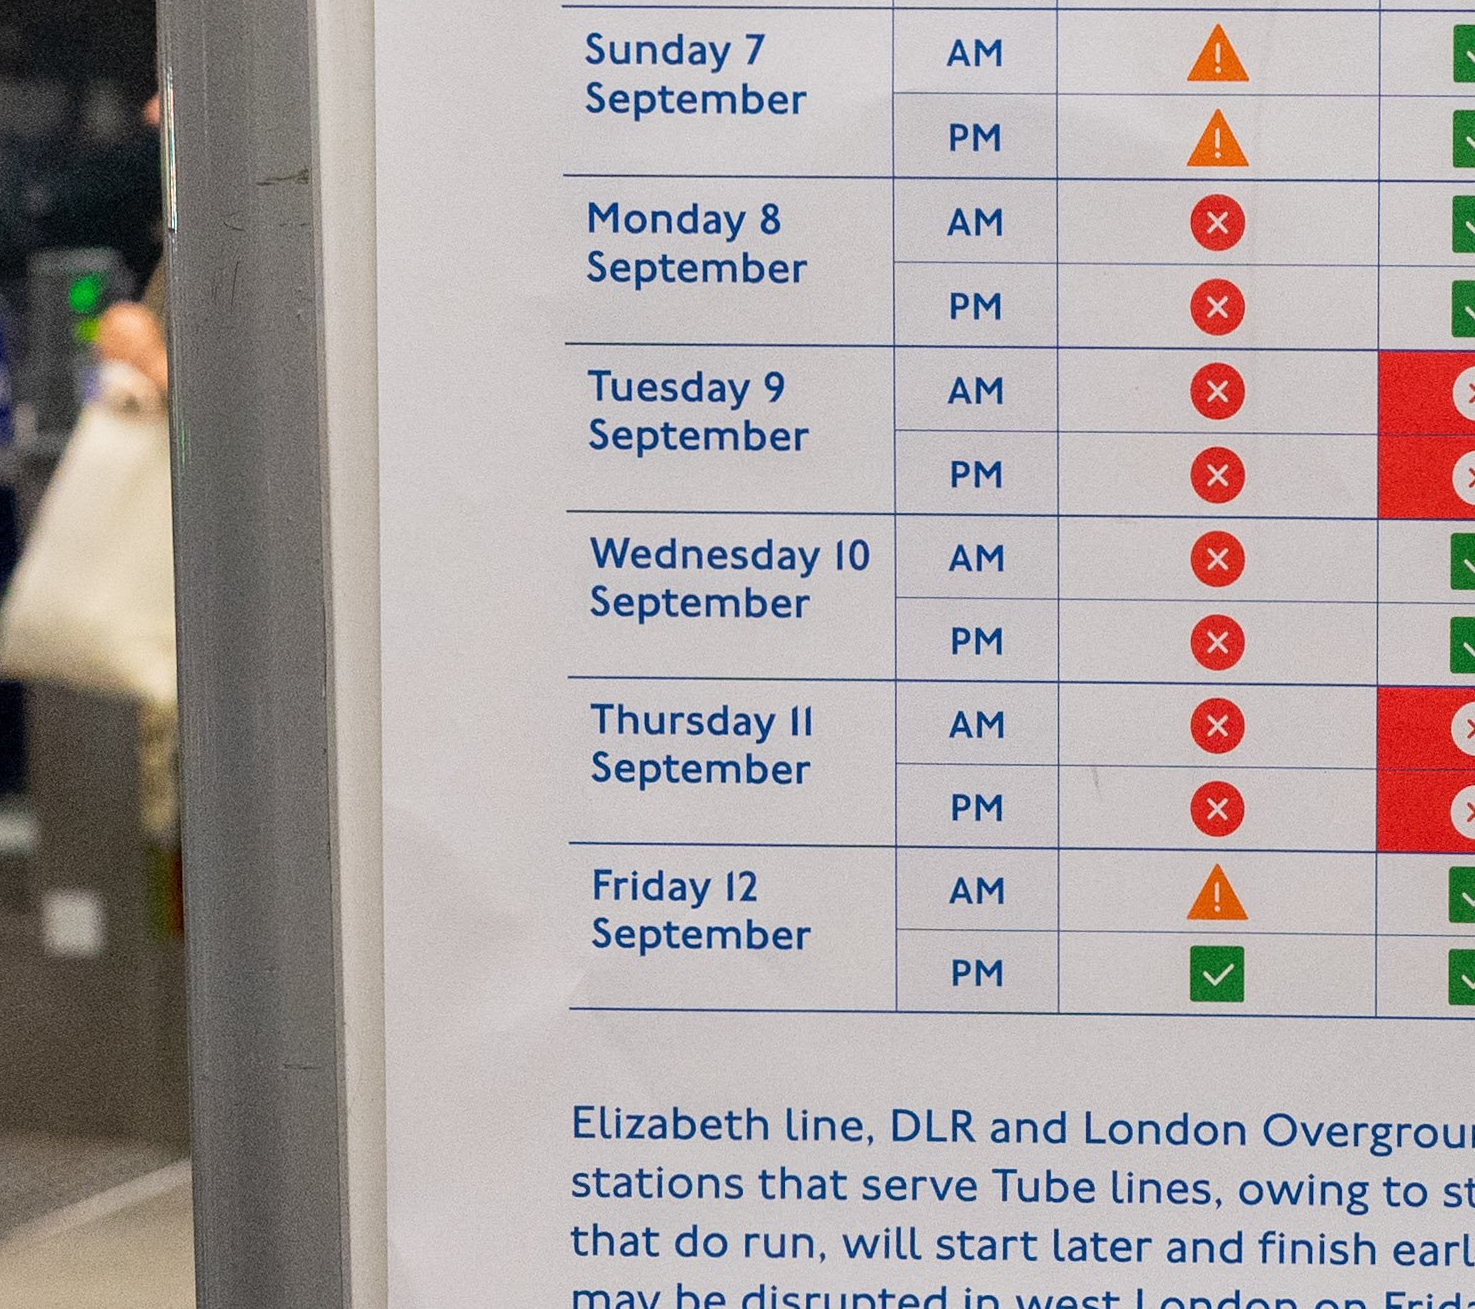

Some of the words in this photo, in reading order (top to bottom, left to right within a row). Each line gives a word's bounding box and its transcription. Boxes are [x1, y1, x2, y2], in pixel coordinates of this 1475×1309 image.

[587, 32, 731, 73] Sunday
[748, 33, 765, 64] 7
[948, 39, 1002, 66] AM
[587, 81, 807, 120] September
[950, 123, 1001, 152] PM
[588, 202, 745, 242] Monday
[760, 202, 780, 235] 8
[947, 208, 1003, 236] AM
[588, 250, 807, 290] September
[950, 292, 1001, 320] PM
[588, 369, 750, 410] Tuesday
[764, 371, 785, 402] 9
[948, 377, 1003, 404] AM
[590, 418, 809, 458] September
[951, 460, 1002, 488] PM
[591, 538, 819, 579] Wednesday
[837, 539, 869, 570] 10
[950, 544, 1004, 571] AM
[591, 584, 810, 624] September
[951, 627, 1002, 655] PM
[591, 703, 775, 744] Thursday
[950, 711, 1004, 739] AM
[592, 751, 811, 790] September
[952, 793, 1003, 821] PM
[593, 868, 710, 909] Friday
[727, 871, 756, 902] 12
[949, 877, 1004, 904] AM
[593, 917, 811, 956] September
[952, 959, 1003, 986] PM
[574, 1105, 769, 1140] Elizabeth
[786, 1107, 873, 1144] line,
[892, 1107, 974, 1143] DLR
[990, 1110, 1067, 1144] and
[1085, 1112, 1246, 1146] London
